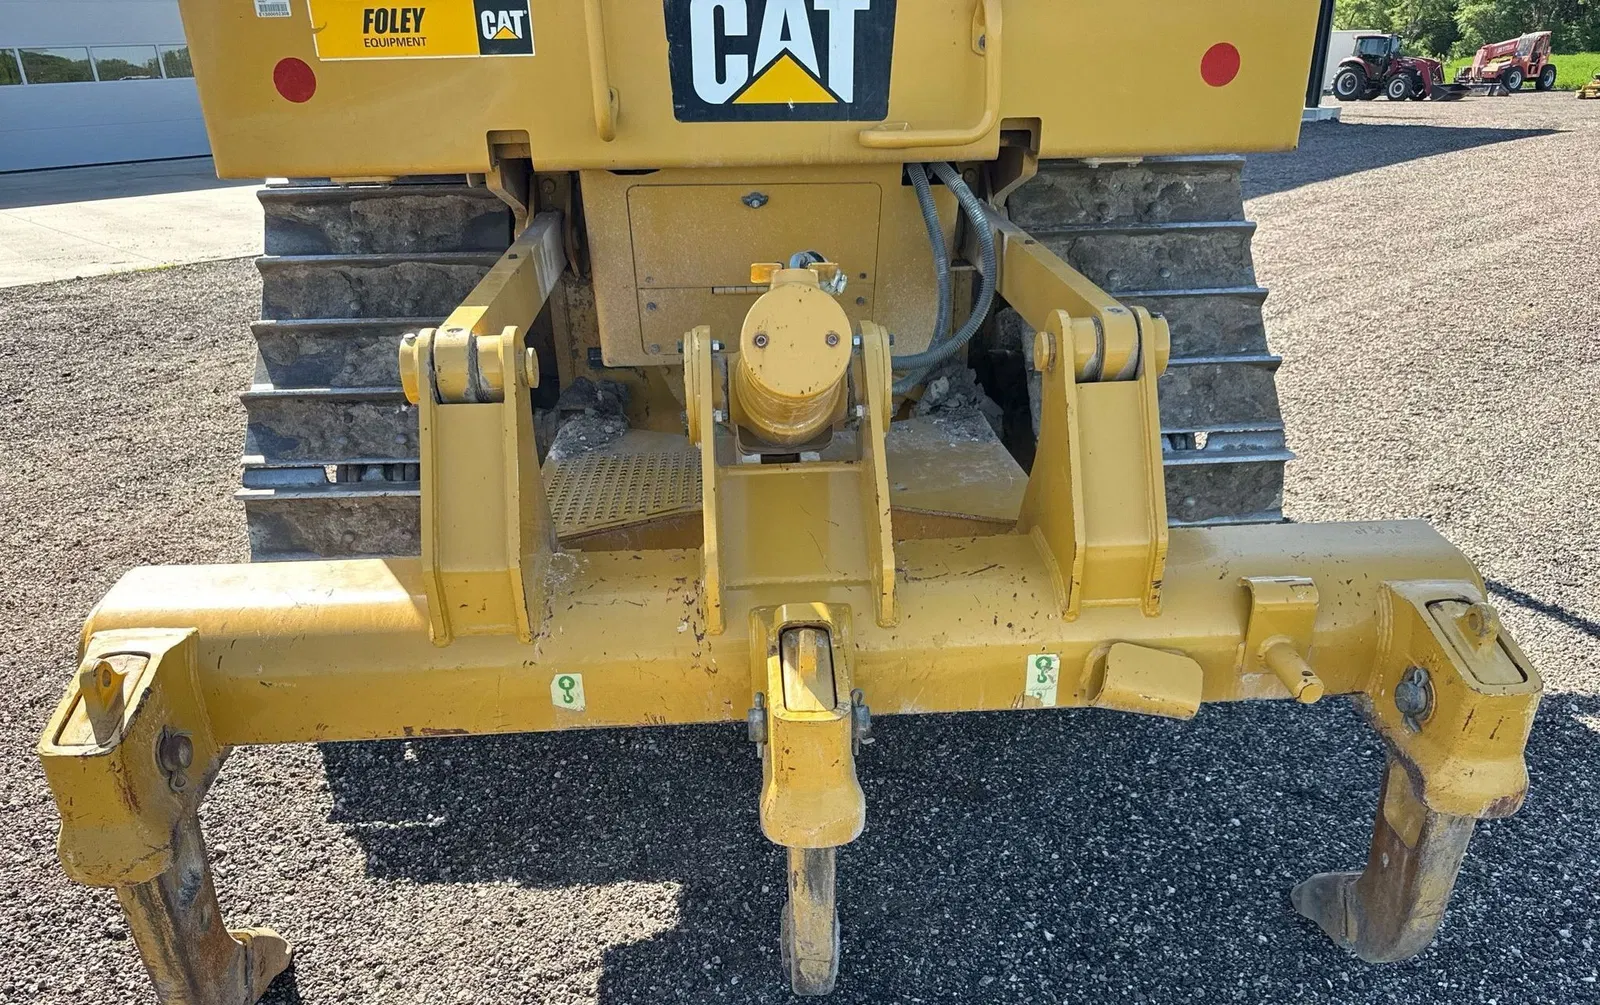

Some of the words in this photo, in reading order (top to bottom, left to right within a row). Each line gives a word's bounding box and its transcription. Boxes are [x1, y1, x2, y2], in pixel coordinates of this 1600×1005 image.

[363, 8, 425, 34] FOLEY
[480, 10, 523, 40] CAT
[364, 37, 427, 48] EQUIPMENT
[690, 0, 870, 104] CAT
